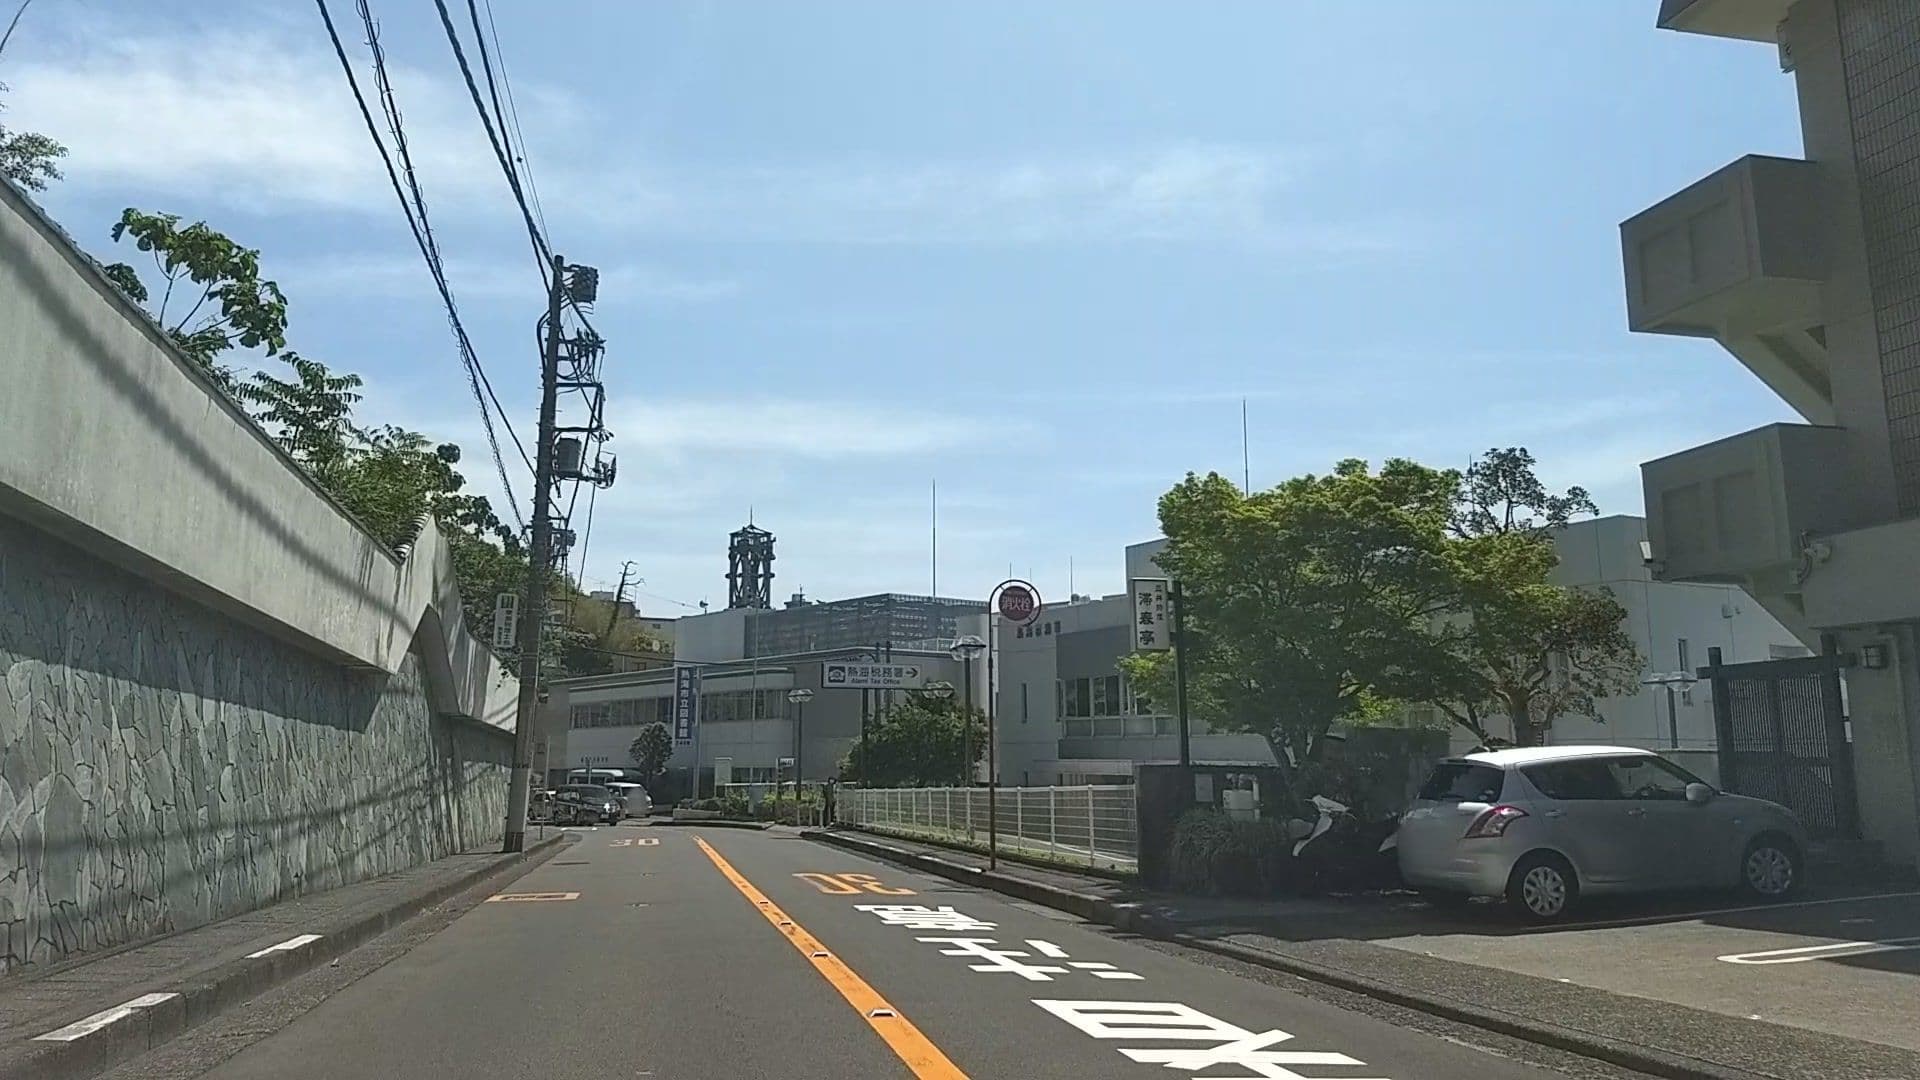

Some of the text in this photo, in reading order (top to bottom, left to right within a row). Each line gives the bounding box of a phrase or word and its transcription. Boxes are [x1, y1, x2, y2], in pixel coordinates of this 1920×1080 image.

[1001, 595, 1031, 611] 消火栓
[848, 666, 903, 678] 熱海税務署
[609, 838, 660, 847] 30
